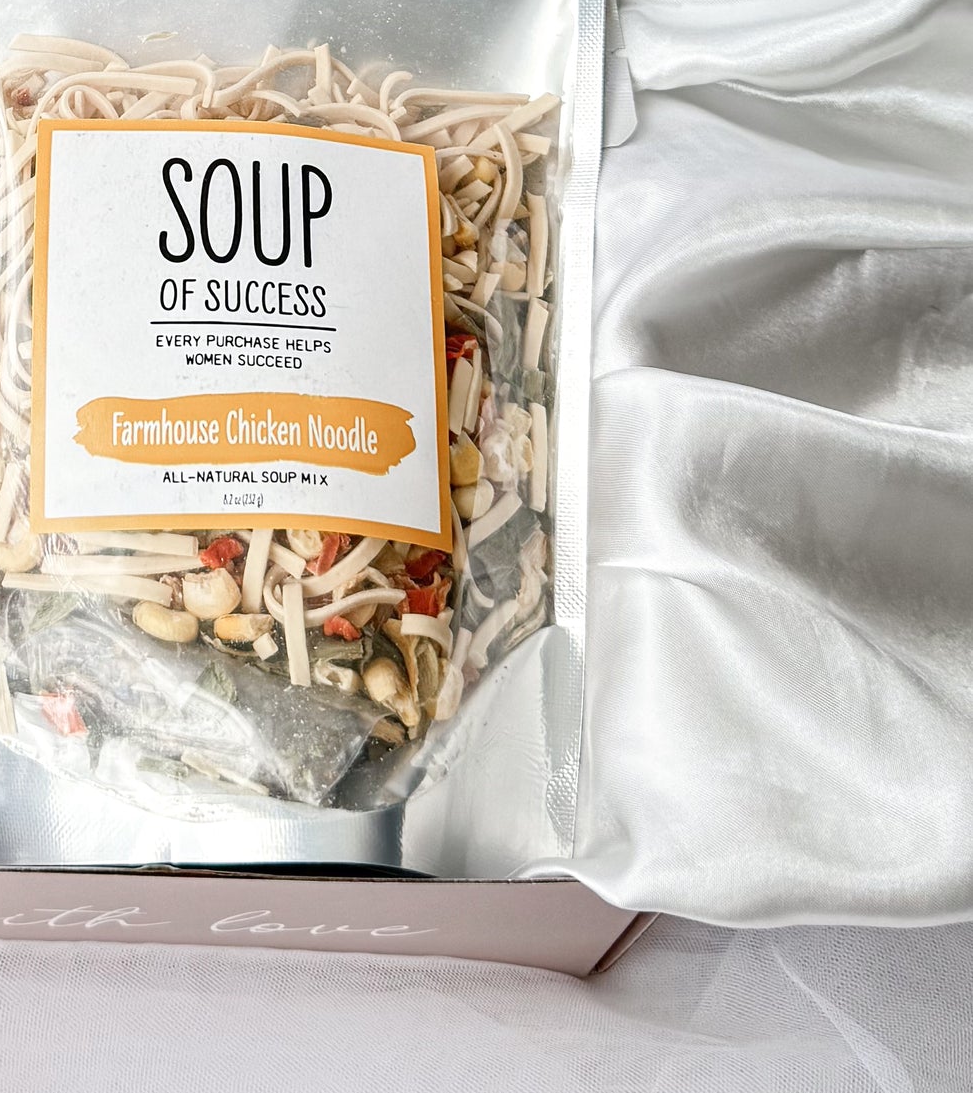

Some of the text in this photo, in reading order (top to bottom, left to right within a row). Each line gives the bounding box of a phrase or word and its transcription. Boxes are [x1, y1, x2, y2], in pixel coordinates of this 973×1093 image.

[159, 157, 333, 268] SOUP
[160, 278, 327, 318] OF SUCCESS
[155, 334, 332, 354] EVERY PURCHASE HELPS
[185, 353, 303, 369] WOMEN SUCCEED
[112, 409, 378, 455] Farmhouse Chicken Noodle
[162, 471, 329, 486] ALL-NATURAL SOUP MIX
[210, 909, 439, 937] love
